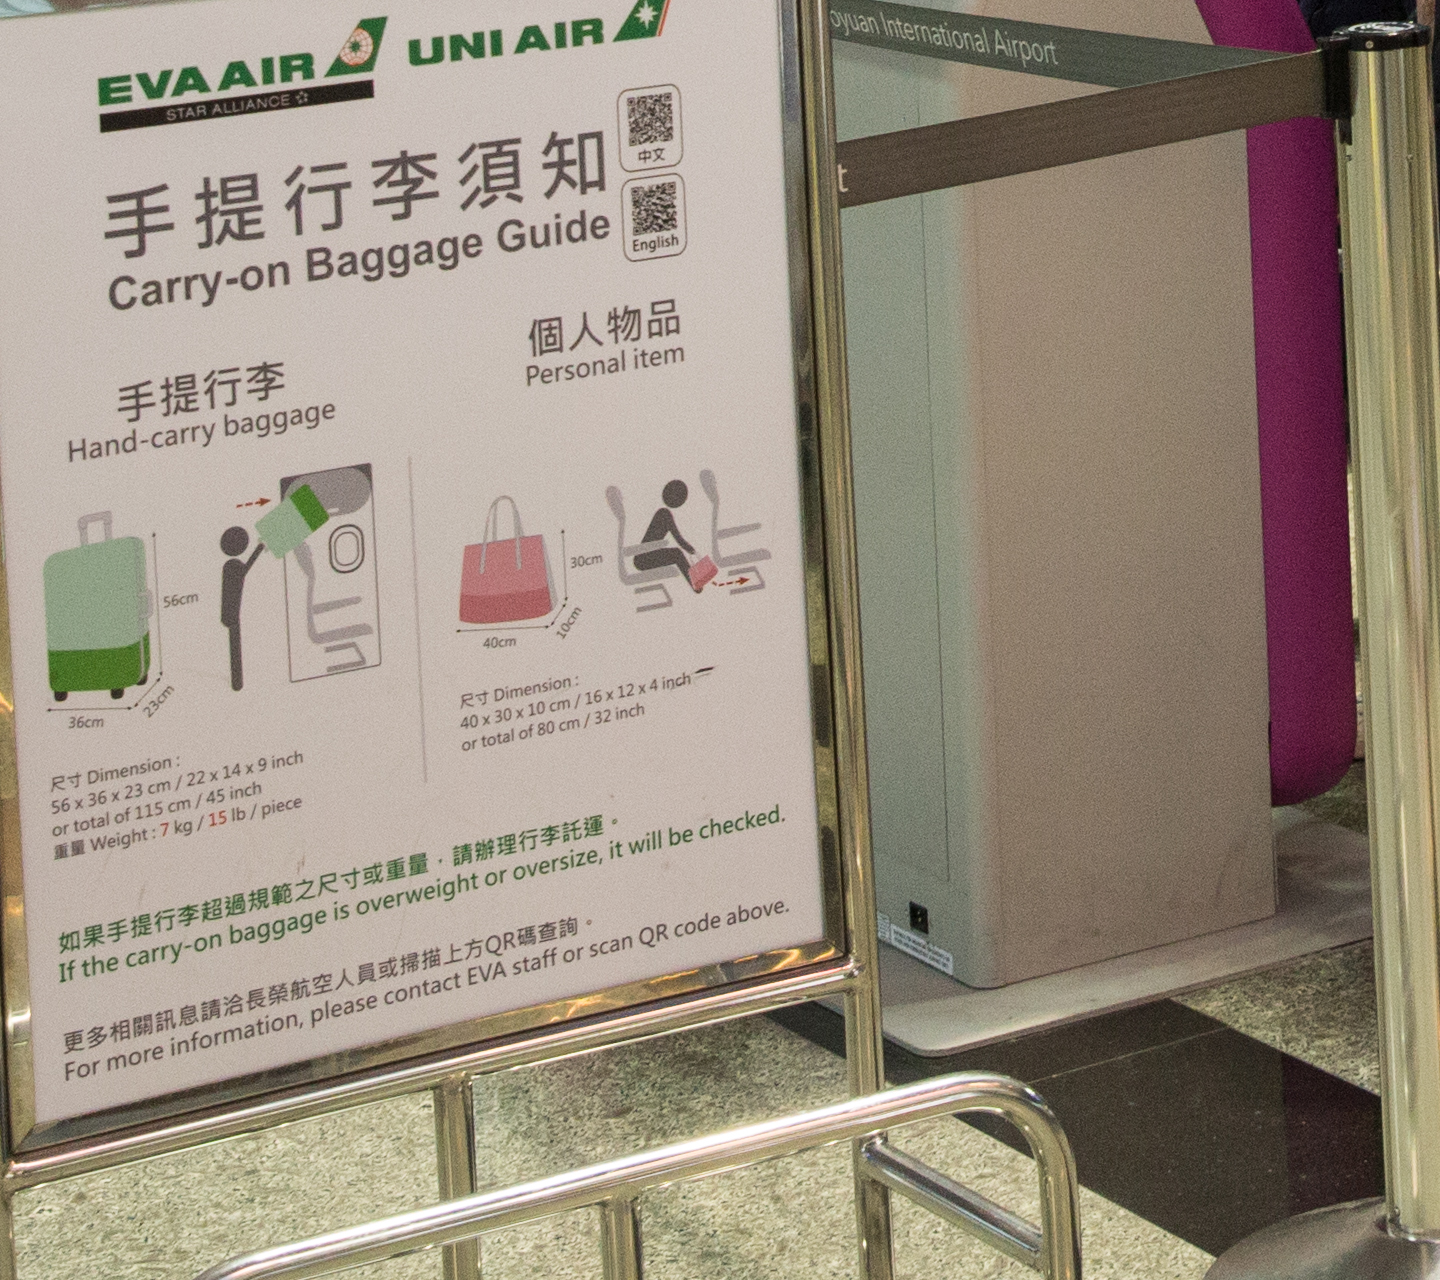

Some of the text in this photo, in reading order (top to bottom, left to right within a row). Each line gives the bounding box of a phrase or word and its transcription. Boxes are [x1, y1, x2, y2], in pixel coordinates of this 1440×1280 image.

[408, 18, 604, 66] UNI AIR
[829, 9, 1059, 68] oyuan International Airport
[166, 92, 292, 122] STAR ALLIANCE
[636, 144, 665, 166] 中文
[103, 129, 607, 260] 手提行李須知
[108, 208, 611, 311] Carry-on Baggage Guide
[632, 230, 683, 257] English
[527, 299, 682, 360] 個人物品
[525, 342, 685, 387] Personal item
[117, 361, 287, 423] 手提行李
[68, 397, 336, 463] Hand-carry baggage
[570, 553, 603, 568] 30cm
[163, 590, 200, 608] 56cm
[556, 605, 583, 640] 10cm
[482, 636, 517, 649] 40cm
[68, 713, 105, 730] 36cm
[142, 683, 175, 718] 23cm
[460, 672, 691, 729] 40 30 10 cm 16 12 4 inch
[461, 691, 488, 709] 尺寸
[462, 703, 645, 751] or total of 80 cm 32 inch
[51, 772, 81, 792] 尺寸
[51, 751, 303, 814] 56 36 23 cm 22 14 9 inch
[52, 782, 262, 837] or total of 115 cm 45 inch
[54, 839, 85, 860] 重量
[160, 822, 169, 837] 7
[174, 820, 193, 836] kg
[209, 810, 227, 827] 15
[231, 807, 246, 822] lb
[261, 798, 302, 819] piece
[59, 804, 785, 983] If the carry-on baggage is overweight or oversize, it will be checked.
[65, 901, 789, 1081] For more information, please contact EVA staff or scan QR code above.
